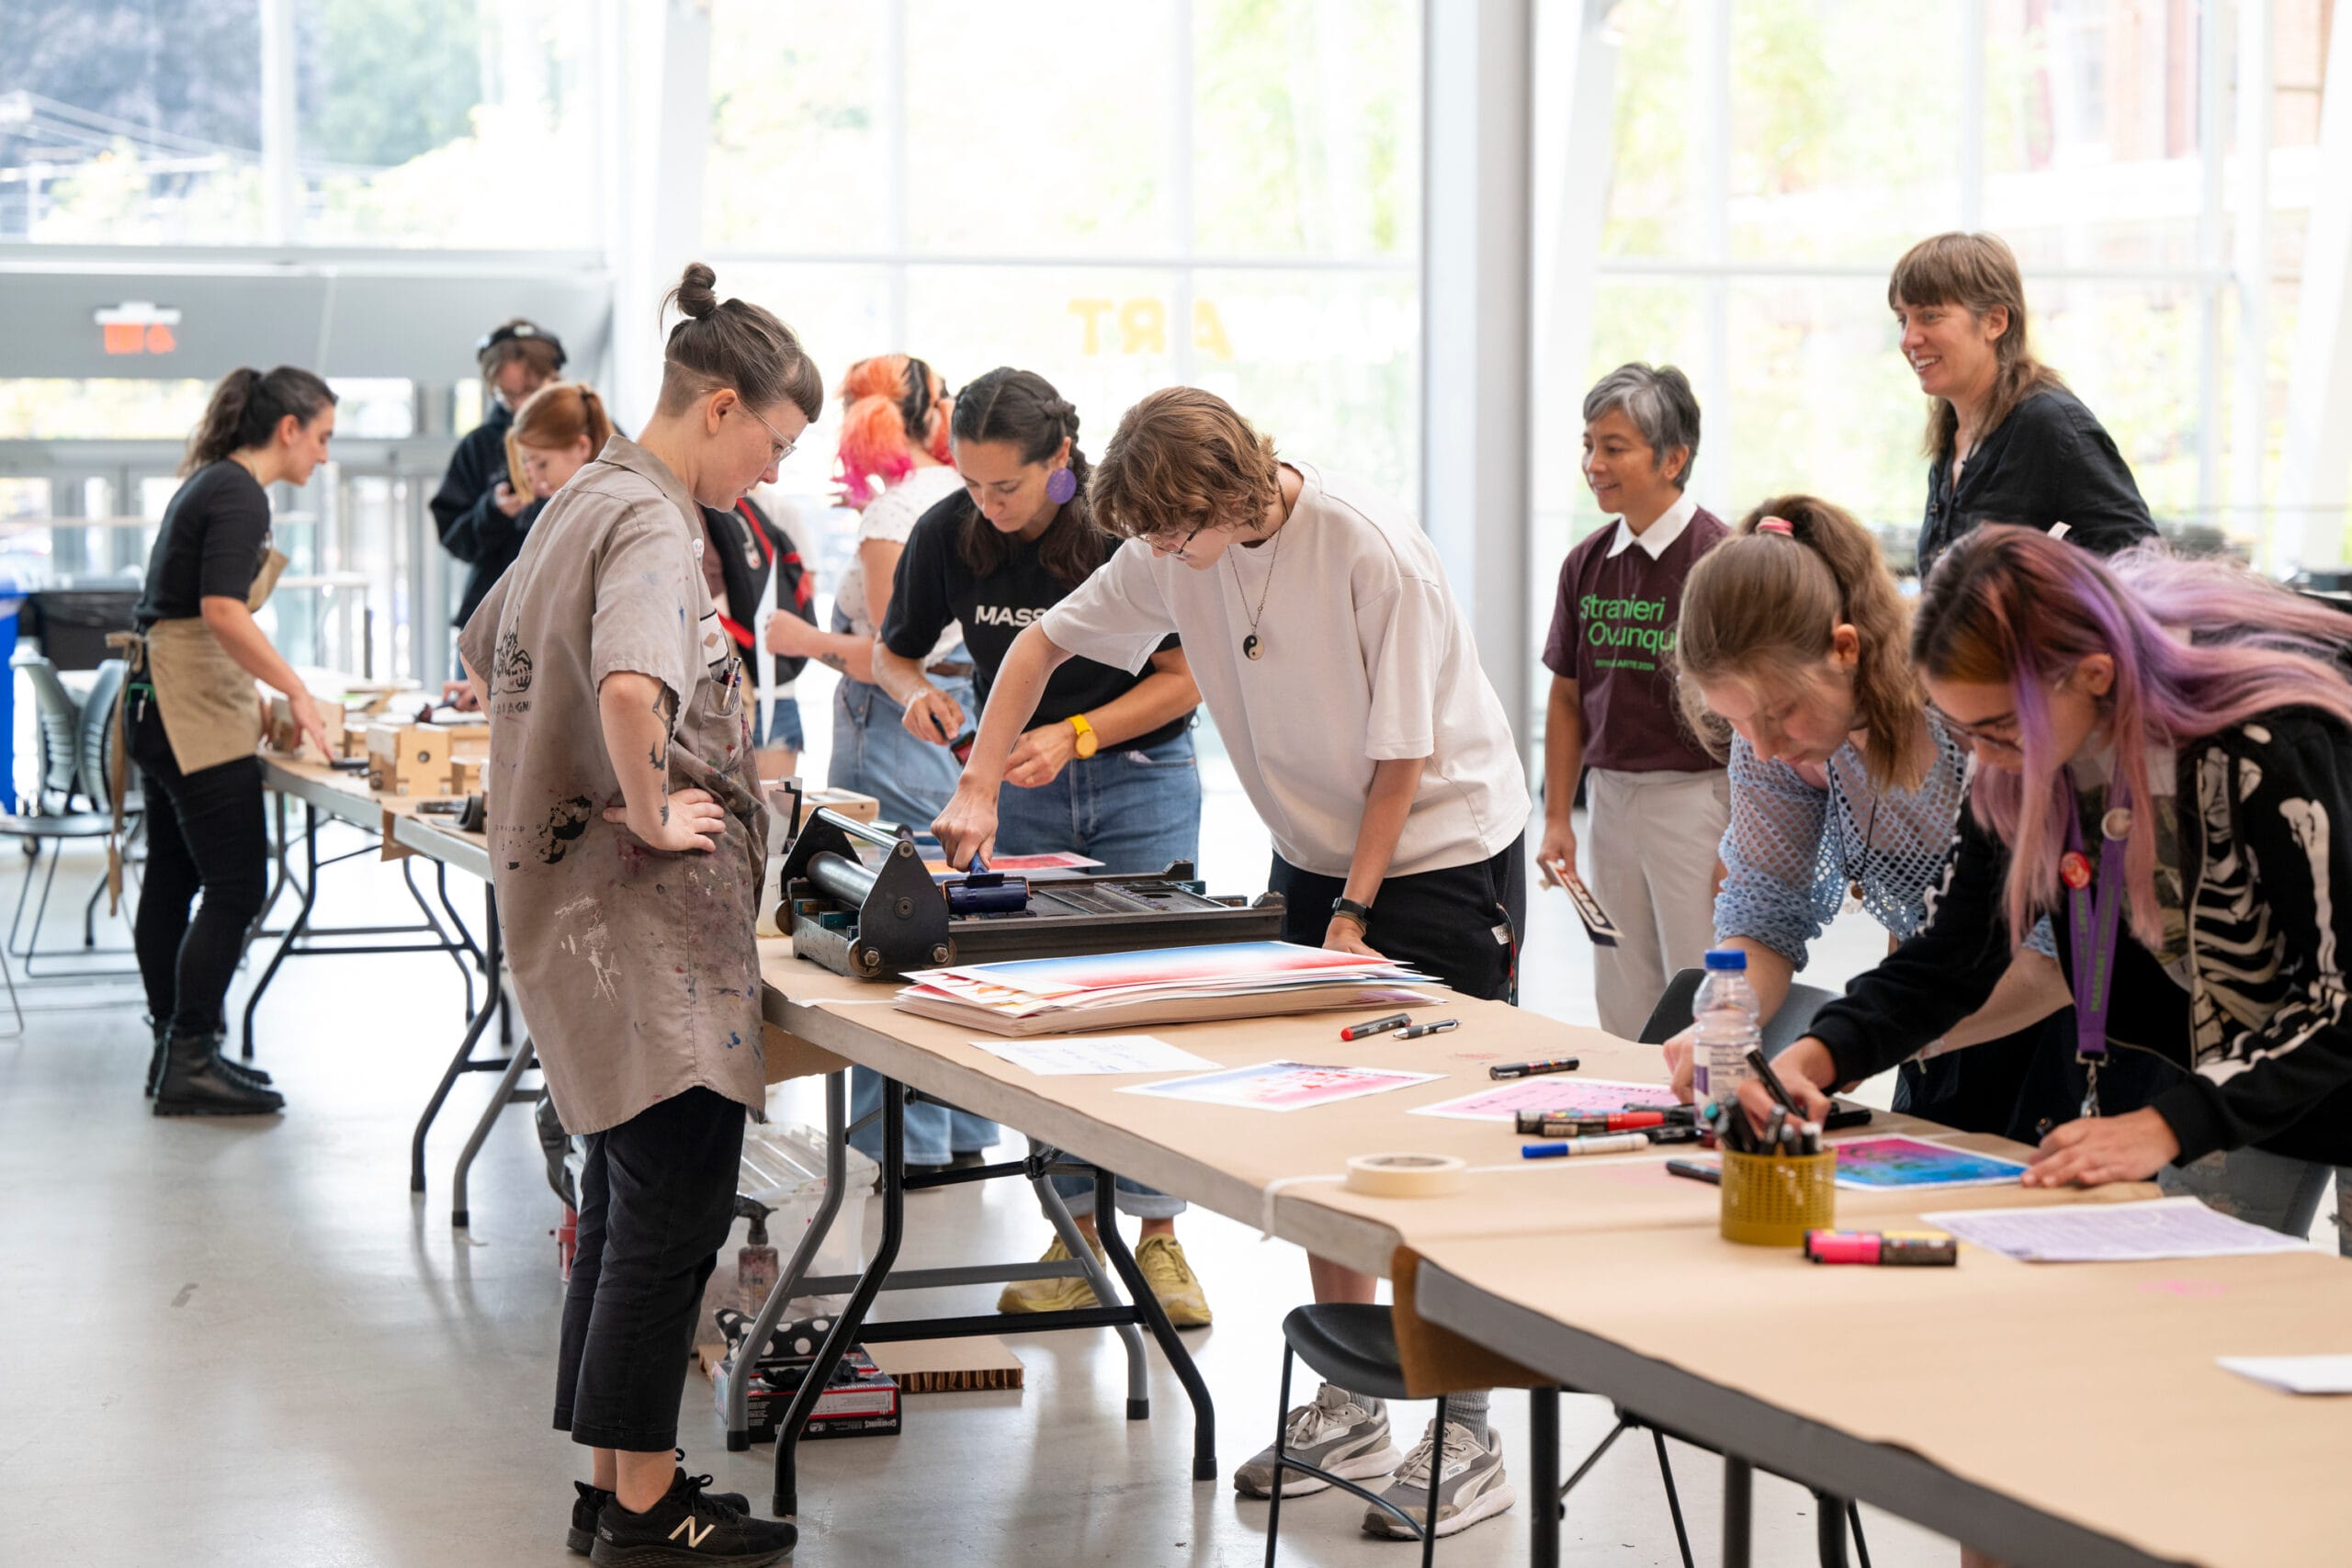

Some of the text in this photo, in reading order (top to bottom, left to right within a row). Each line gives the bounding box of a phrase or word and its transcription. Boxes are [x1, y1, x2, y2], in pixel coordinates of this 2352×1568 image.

[1579, 593, 1667, 622] Stranieri
[1588, 621, 1676, 655] Ovunqu
[667, 1515, 716, 1549] N
